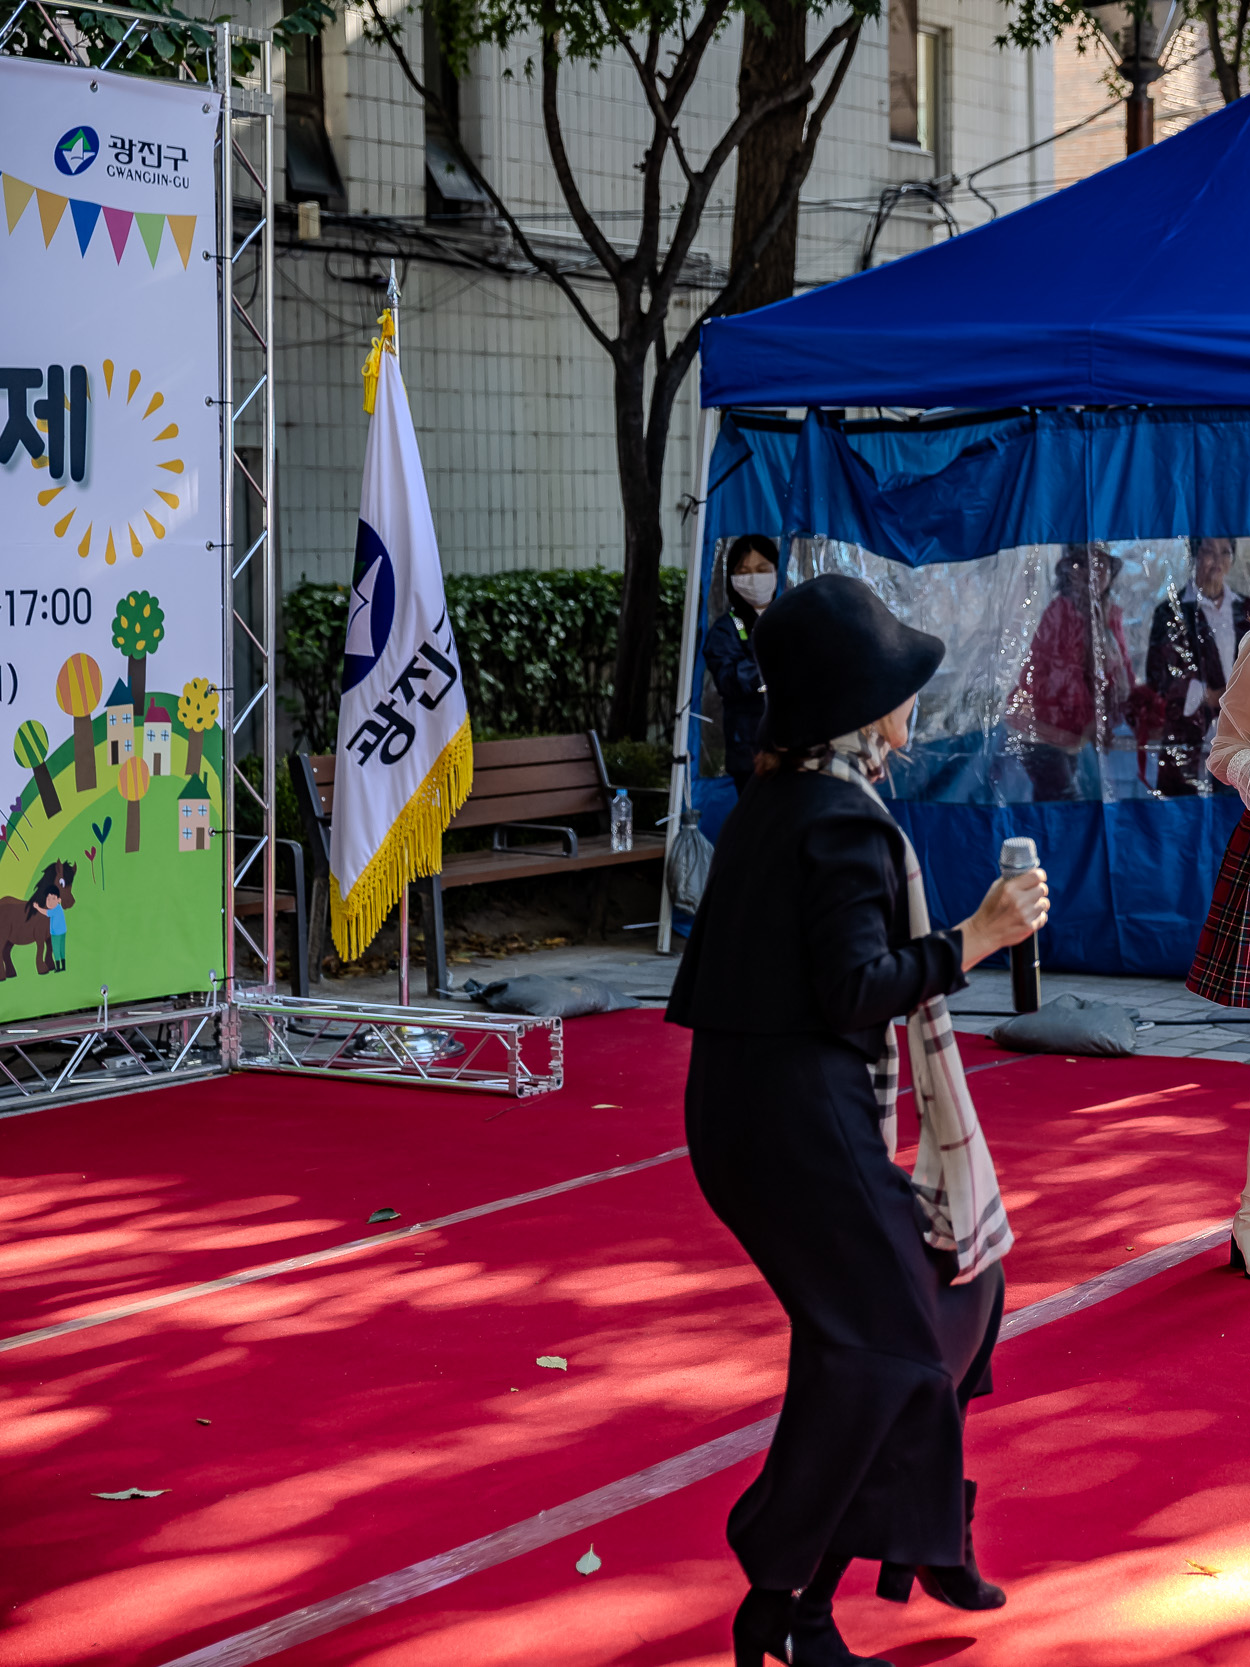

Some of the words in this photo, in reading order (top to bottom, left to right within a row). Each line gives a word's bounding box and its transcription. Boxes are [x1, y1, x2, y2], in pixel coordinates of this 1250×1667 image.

[108, 134, 189, 171] 광진구
[106, 164, 190, 189] GWANGJIN-GU
[0, 588, 92, 627] 17:00
[345, 602, 458, 767] 광진
